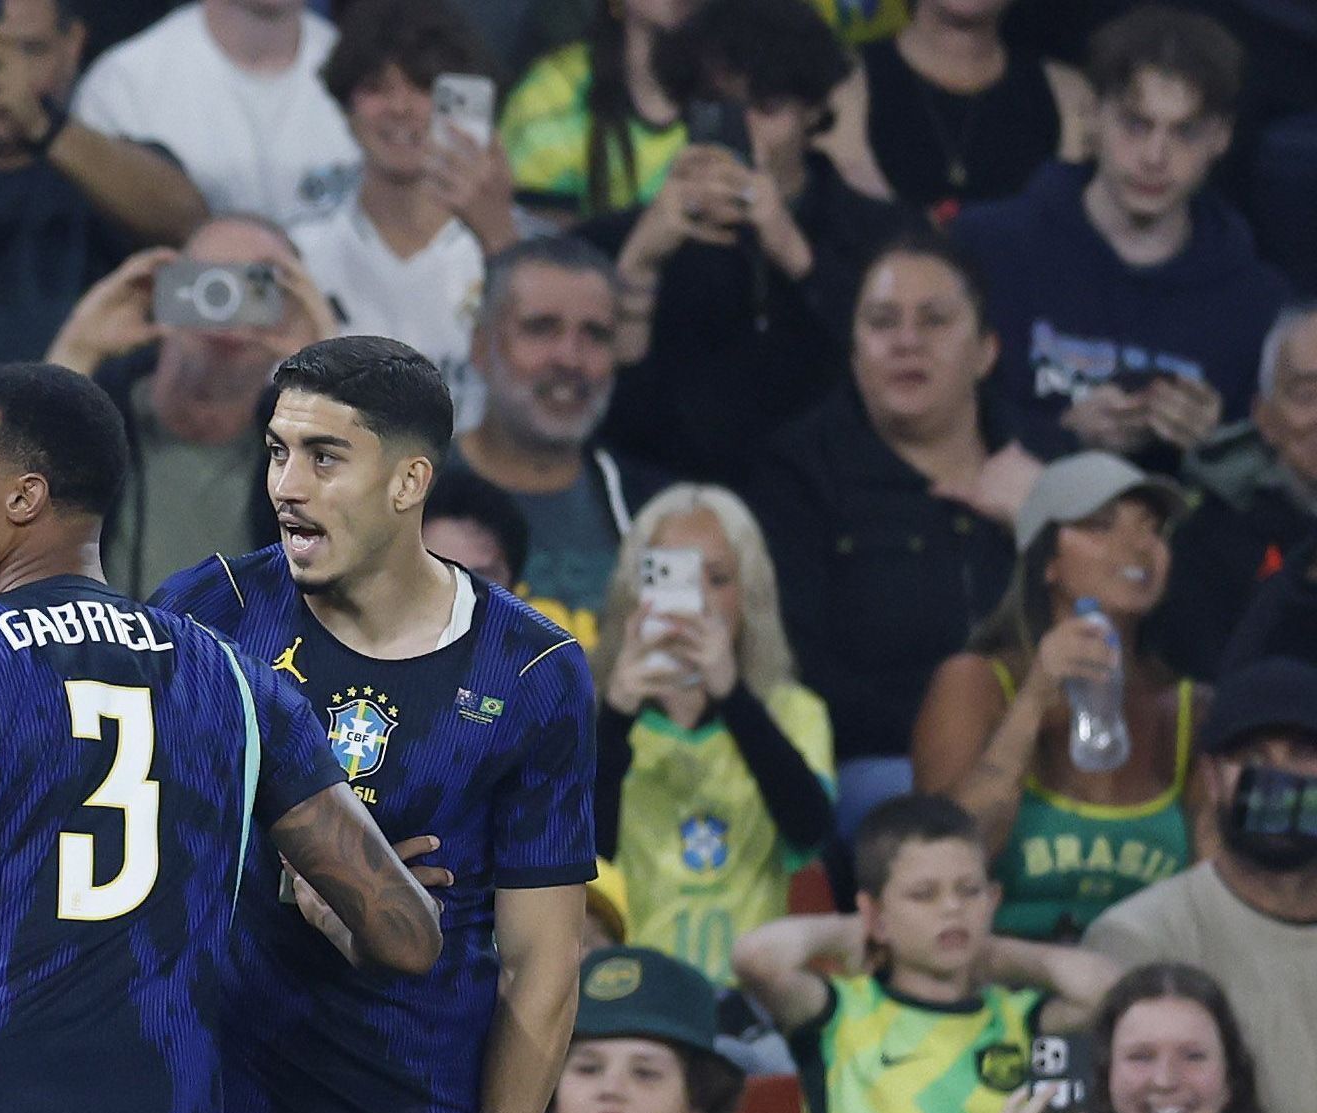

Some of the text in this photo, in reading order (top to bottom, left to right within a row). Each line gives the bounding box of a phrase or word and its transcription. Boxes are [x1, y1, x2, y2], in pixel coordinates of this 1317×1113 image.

[346, 731, 369, 744] CBF
[57, 680, 160, 921] 3
[353, 785, 377, 804] SIL
